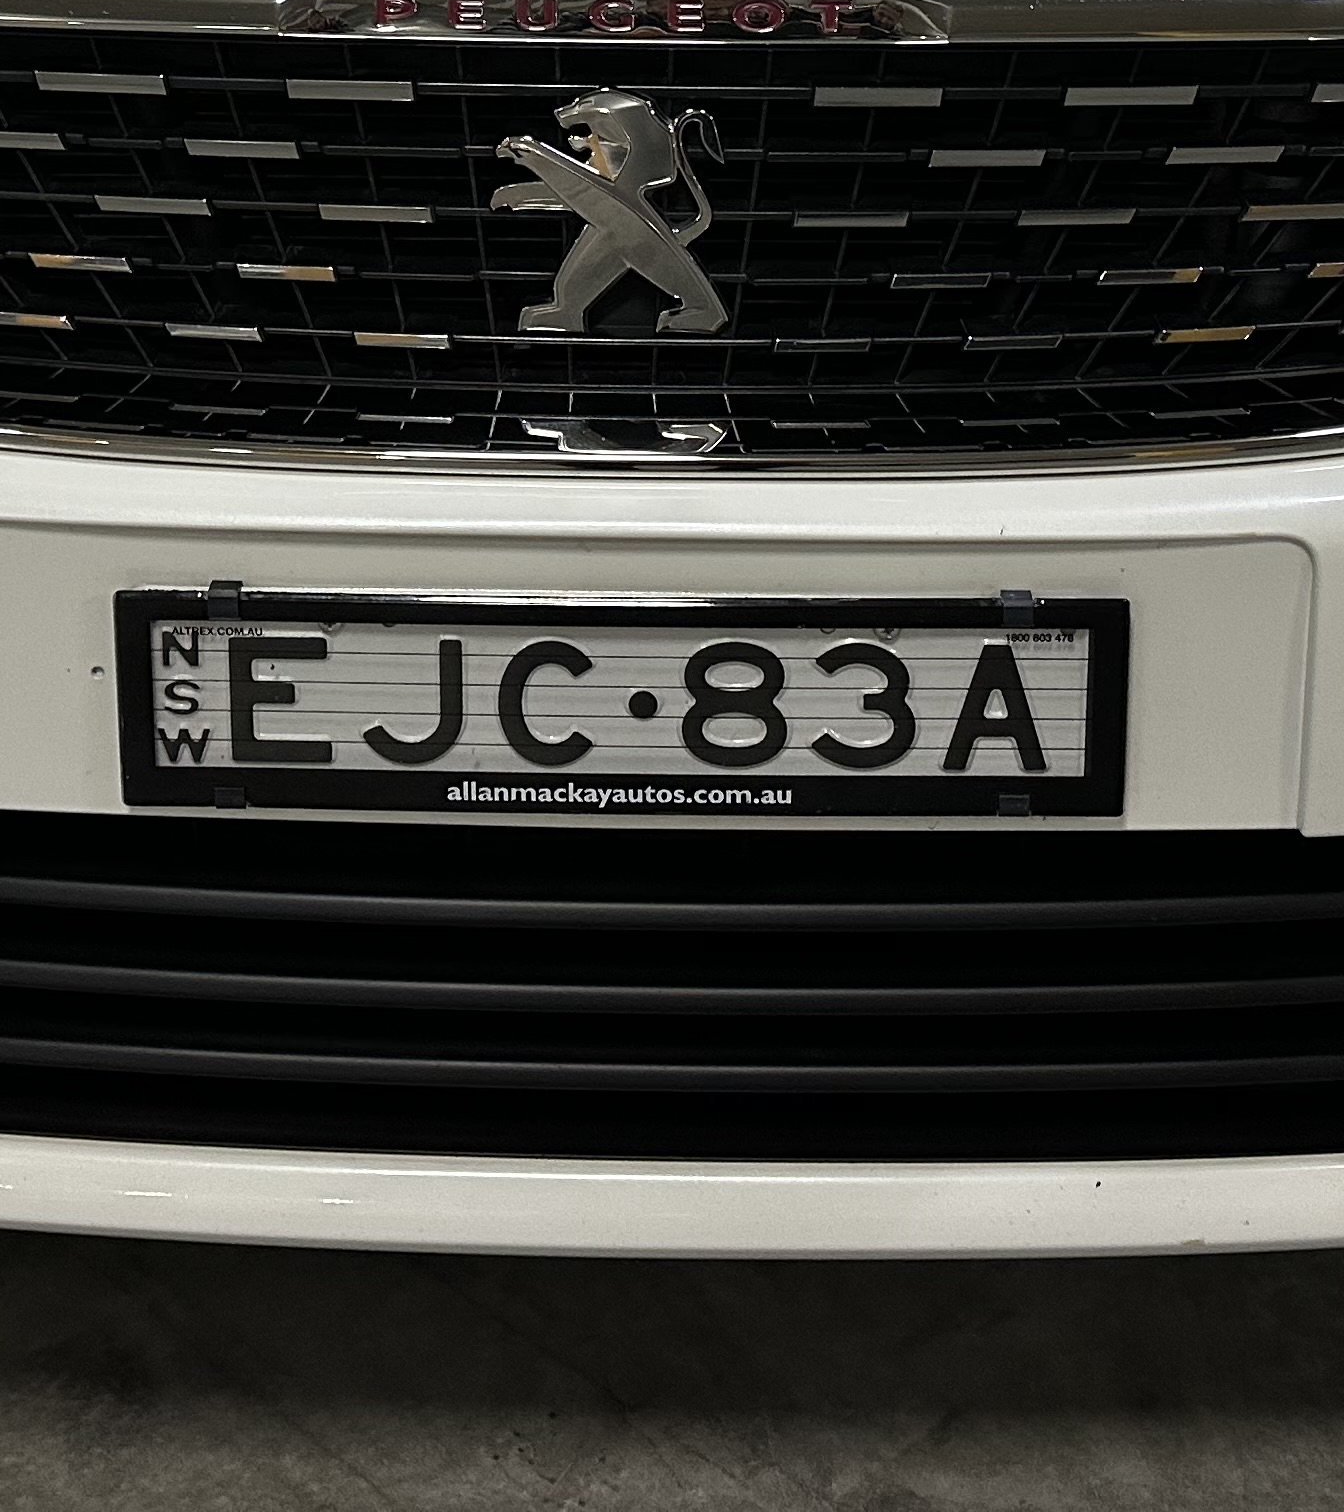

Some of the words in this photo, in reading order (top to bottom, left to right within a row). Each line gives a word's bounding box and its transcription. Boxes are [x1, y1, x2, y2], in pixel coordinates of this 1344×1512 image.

[1005, 633, 1031, 643] 1800
[158, 630, 211, 763] NSW
[447, 781, 793, 809] allanmackayautos.com.au
